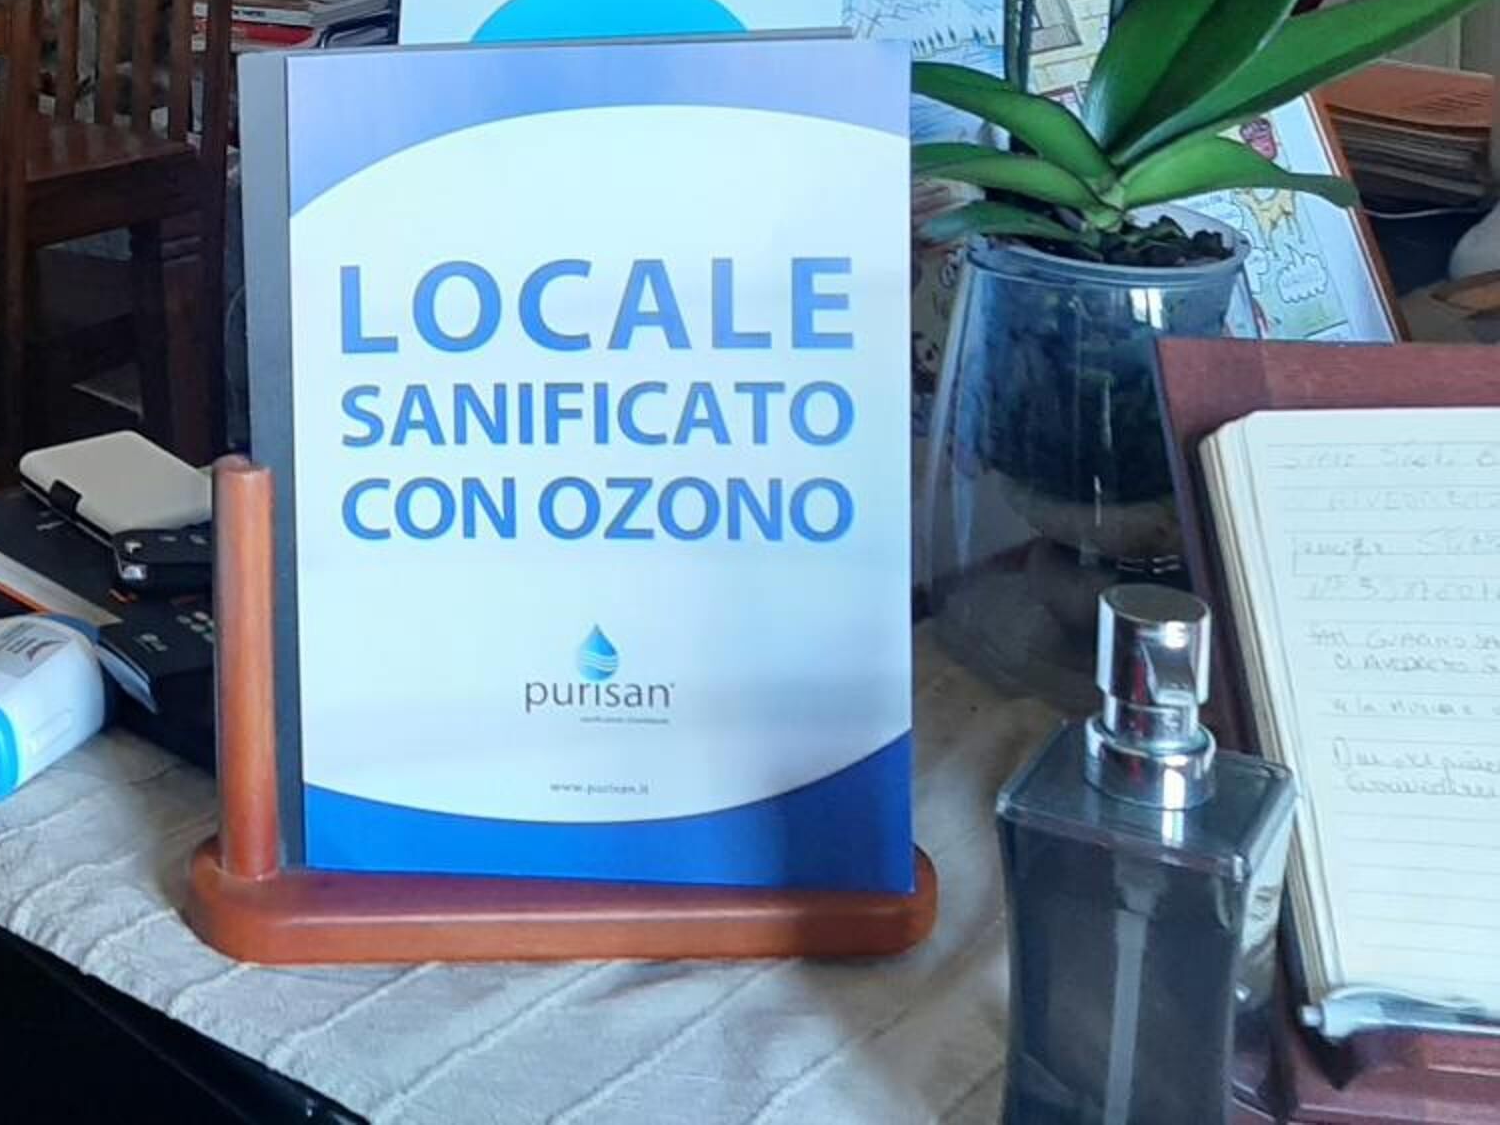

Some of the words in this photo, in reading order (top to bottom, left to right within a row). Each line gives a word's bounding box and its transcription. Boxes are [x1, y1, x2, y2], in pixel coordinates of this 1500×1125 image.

[340, 257, 854, 354] LOCALE
[341, 380, 854, 448] SANIFICATO
[341, 476, 516, 541] CON
[538, 476, 854, 543] OZONO
[525, 682, 670, 713] purisan
[550, 782, 649, 795] www.purisan.it
